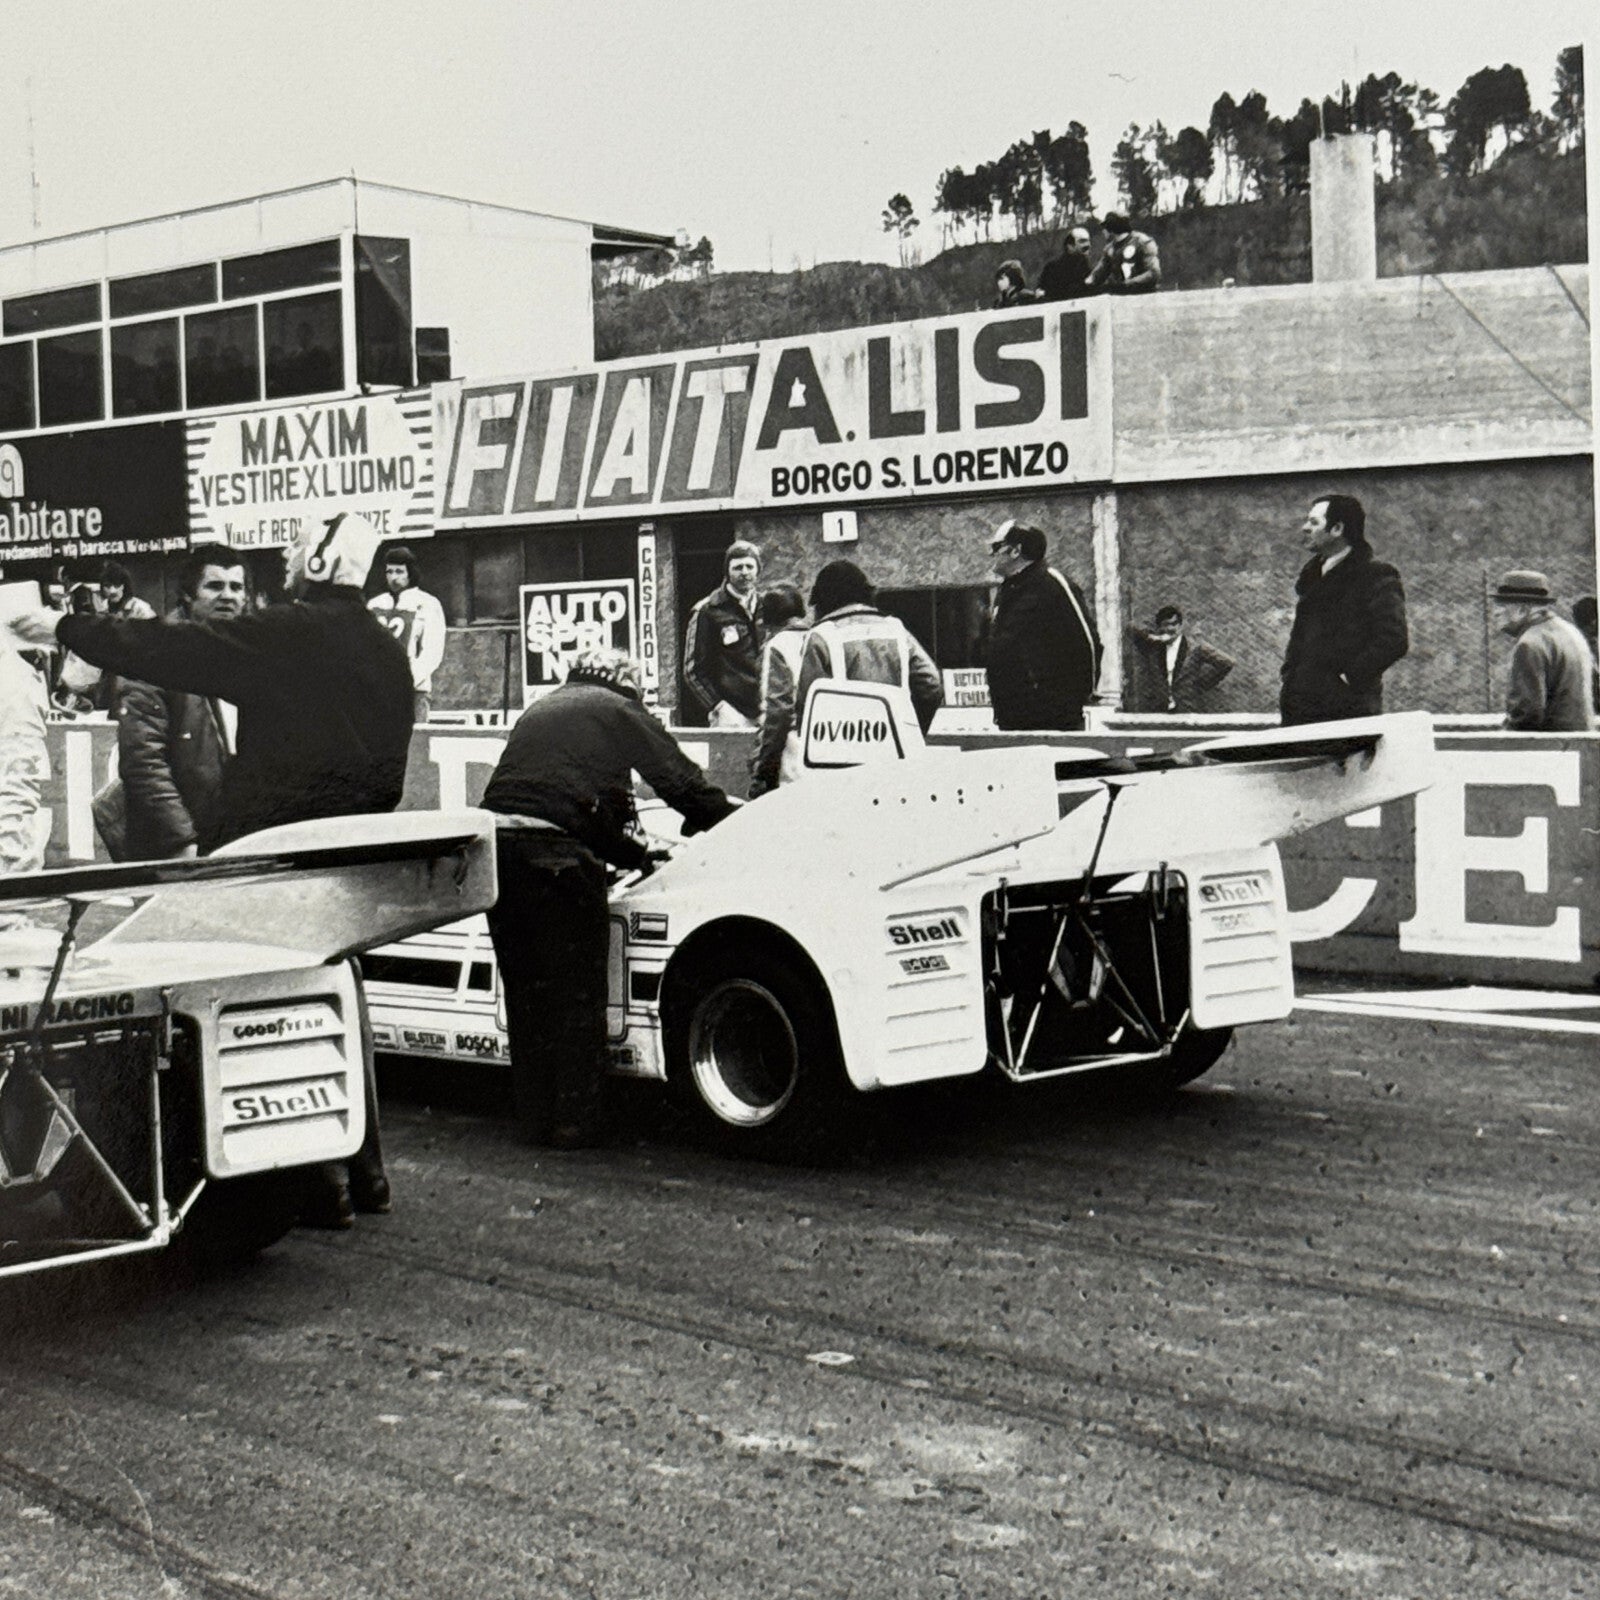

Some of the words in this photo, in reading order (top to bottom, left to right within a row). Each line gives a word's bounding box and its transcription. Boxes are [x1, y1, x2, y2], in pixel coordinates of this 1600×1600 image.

[240, 405, 368, 467] MAXIM
[446, 361, 751, 511] FIAT
[771, 460, 872, 497] BORGO
[913, 441, 1069, 487] LORENZO
[0, 500, 103, 543] abitare
[837, 518, 844, 538] 1
[527, 591, 627, 626] AUTO
[642, 548, 655, 678] CASTROL
[813, 719, 887, 743] OVORO
[888, 917, 962, 946] Shell
[455, 1033, 500, 1053] BOSCH
[233, 1087, 332, 1120] Shell
